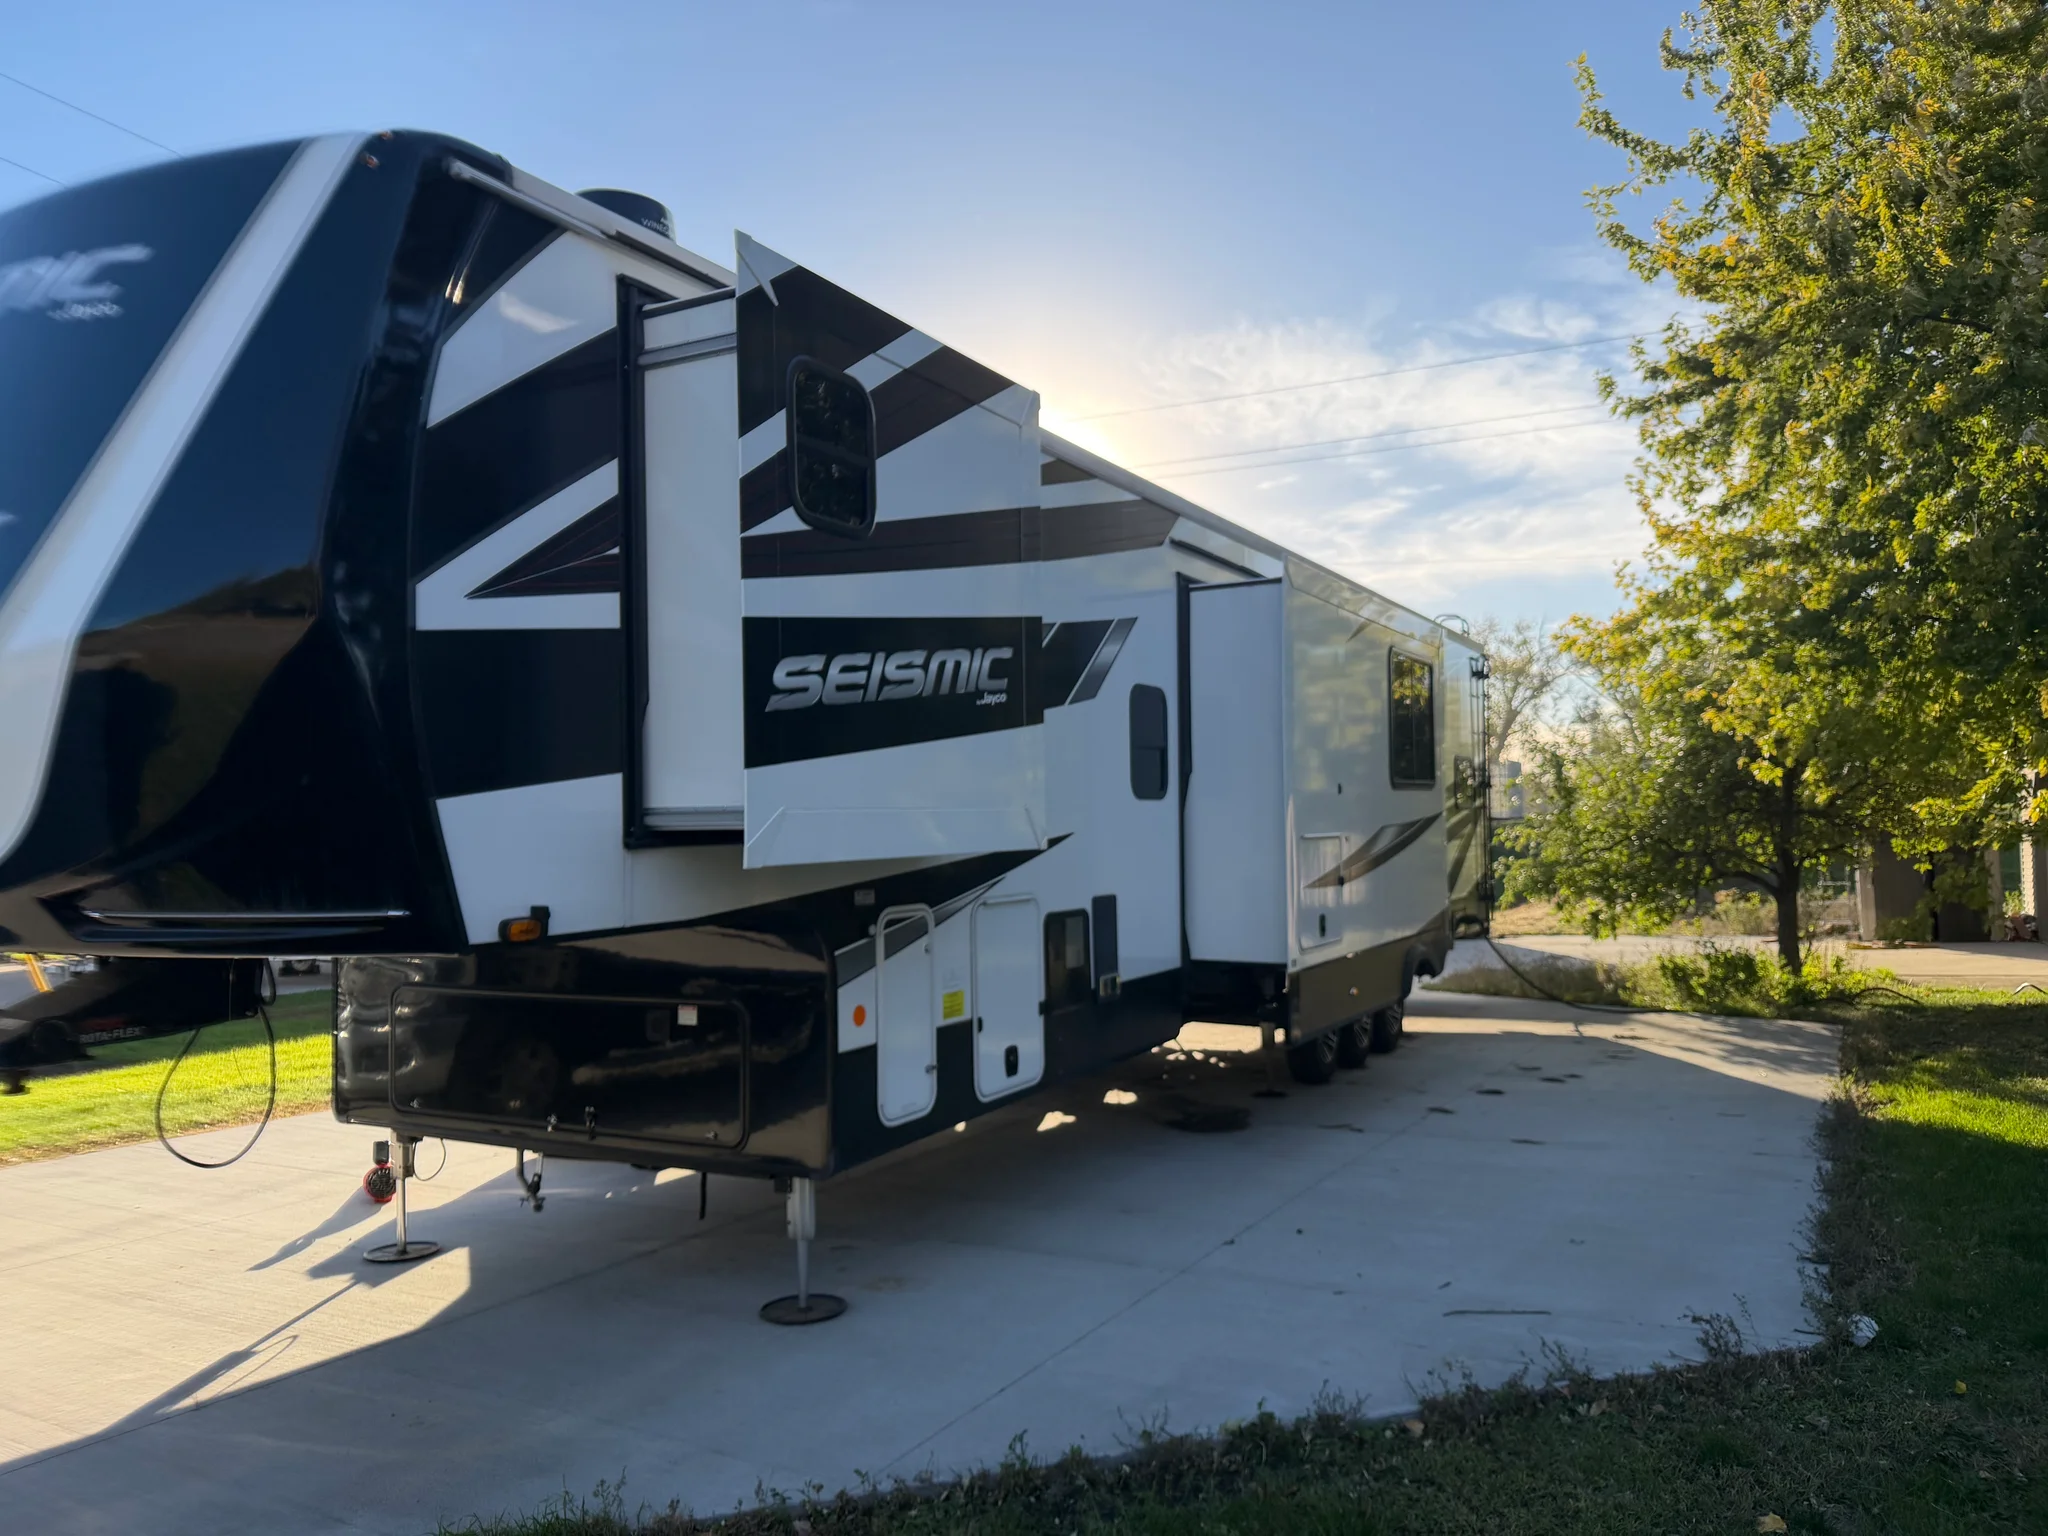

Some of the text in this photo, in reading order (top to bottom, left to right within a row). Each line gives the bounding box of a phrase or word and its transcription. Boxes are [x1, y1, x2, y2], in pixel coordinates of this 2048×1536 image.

[765, 646, 1013, 712] SEISMIC
[983, 692, 1007, 706] Jayco
[80, 1027, 142, 1043] ROTA-FLEX
